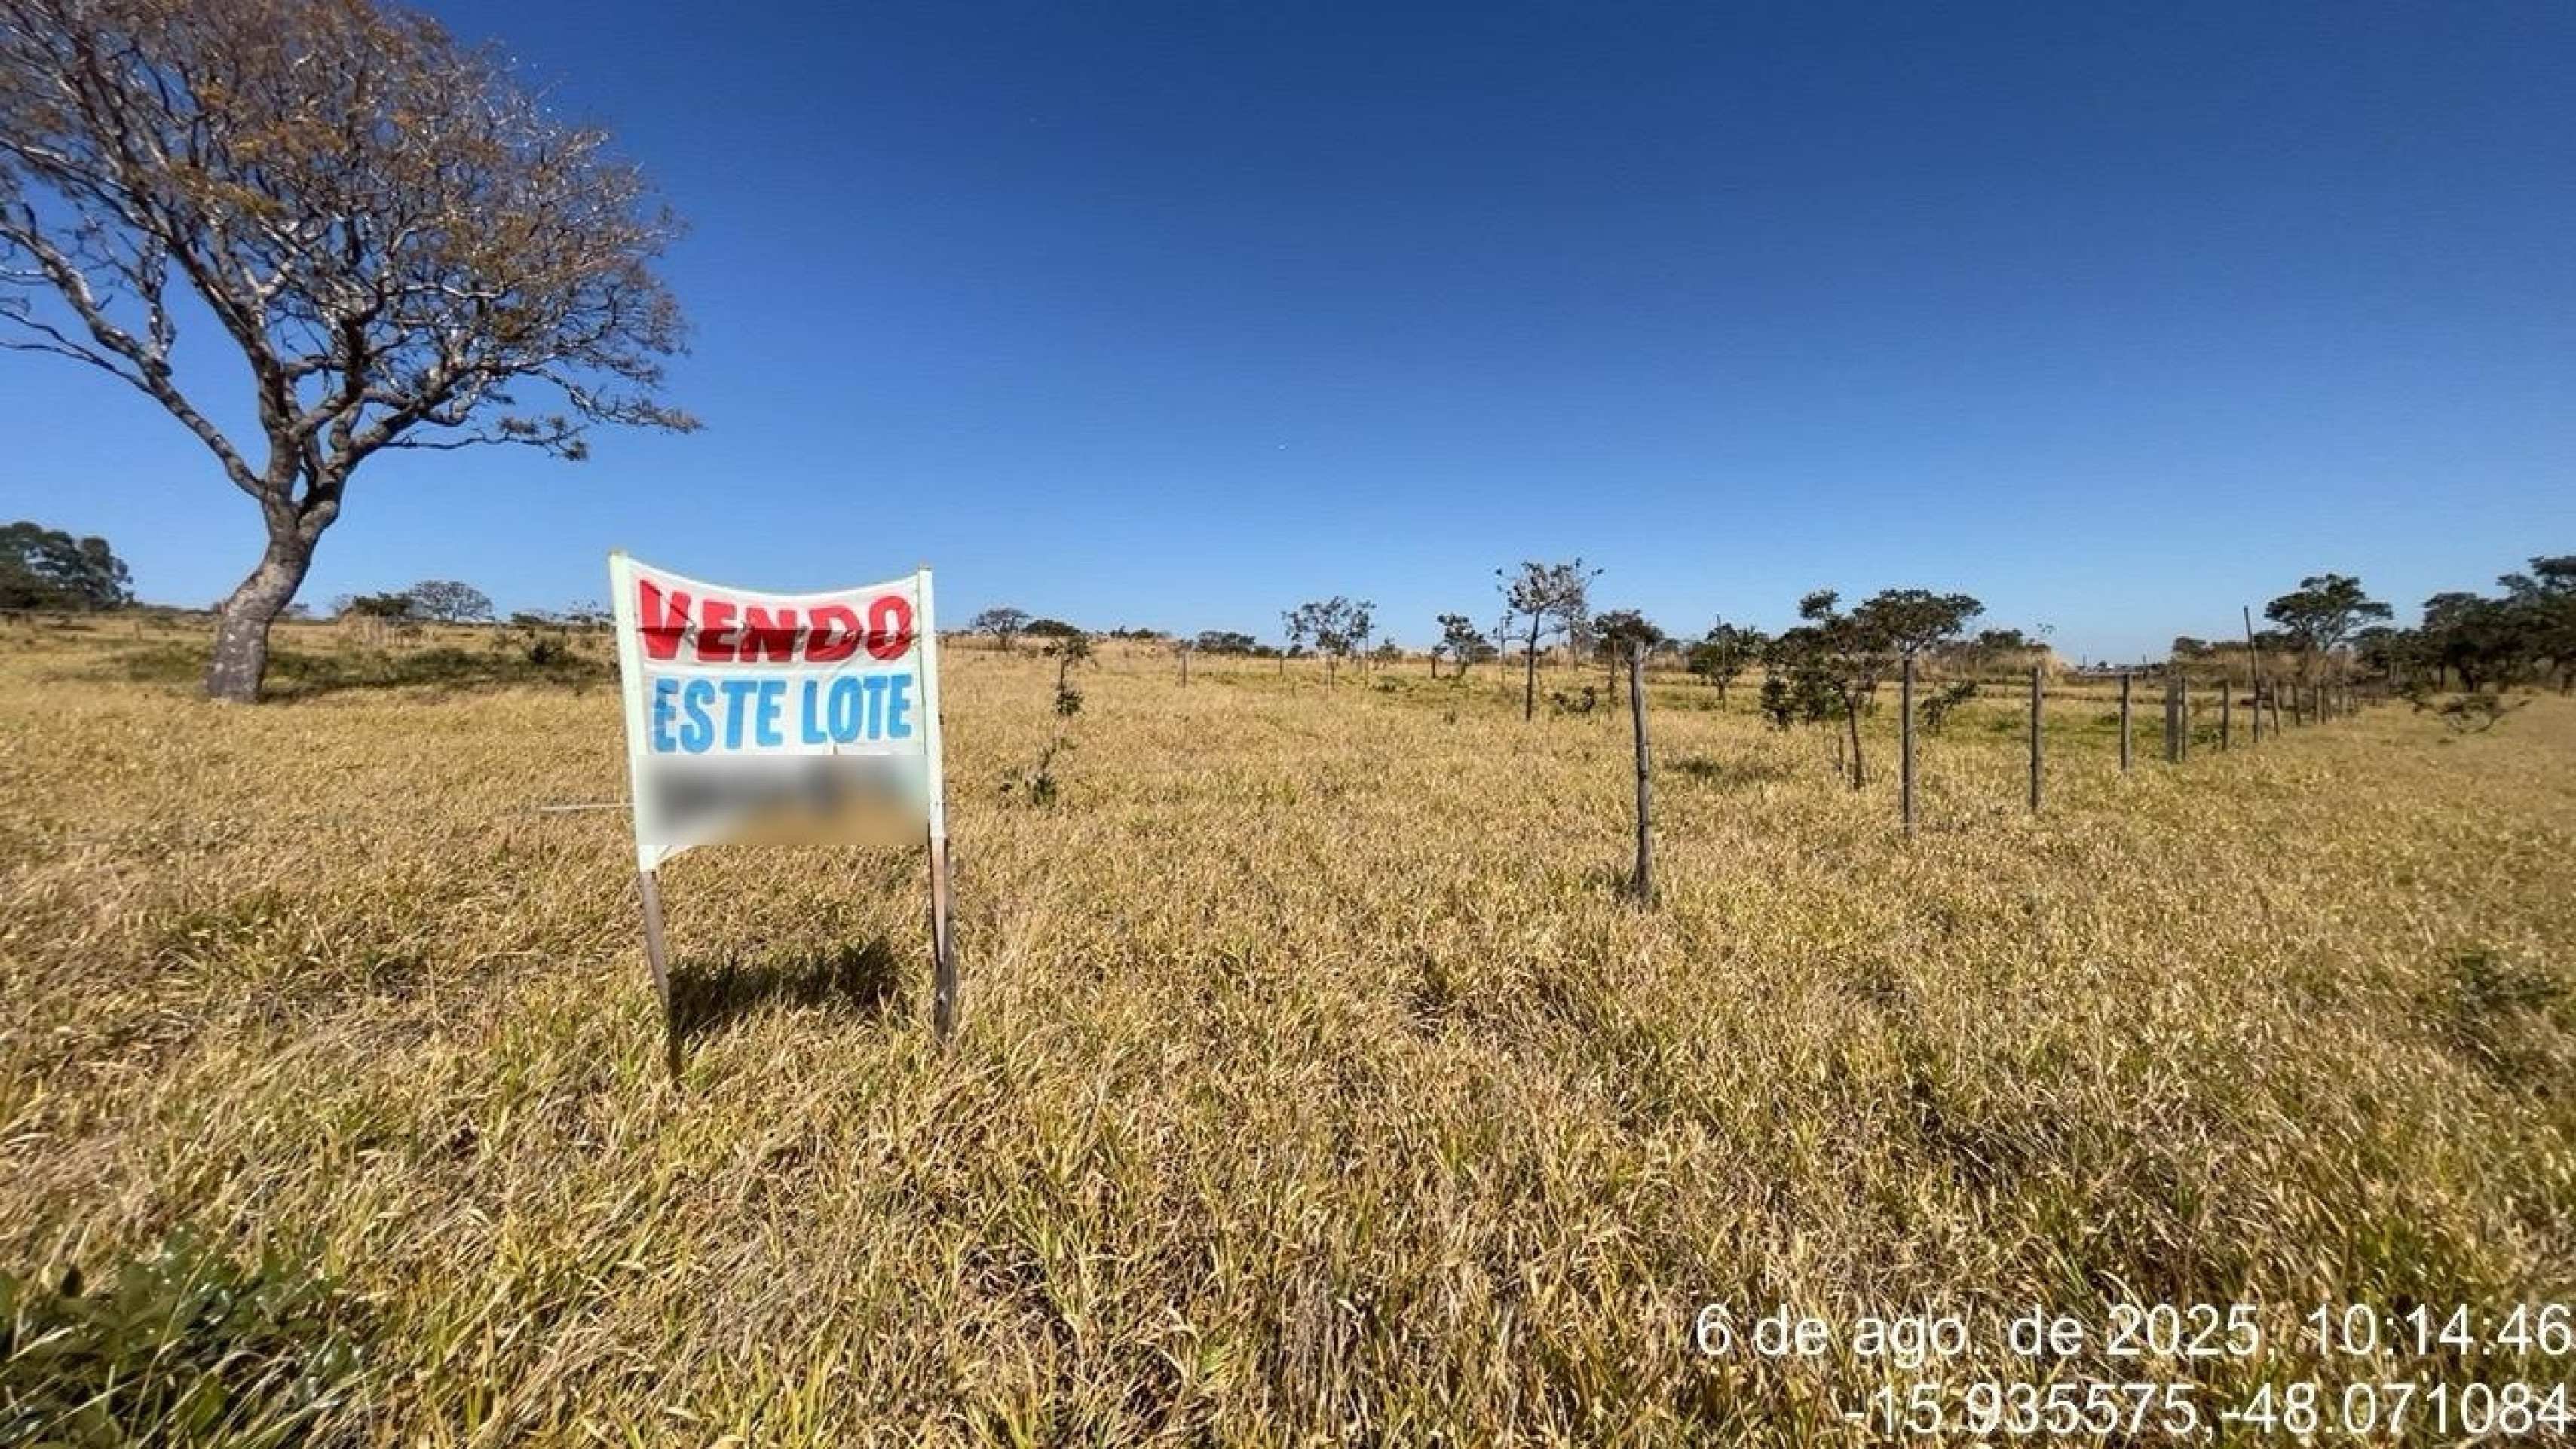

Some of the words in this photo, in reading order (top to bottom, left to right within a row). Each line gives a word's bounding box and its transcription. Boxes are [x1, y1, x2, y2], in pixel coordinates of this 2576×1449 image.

[639, 579, 912, 663] VENDO
[654, 676, 787, 754] ESTE
[801, 674, 912, 746] LOTE
